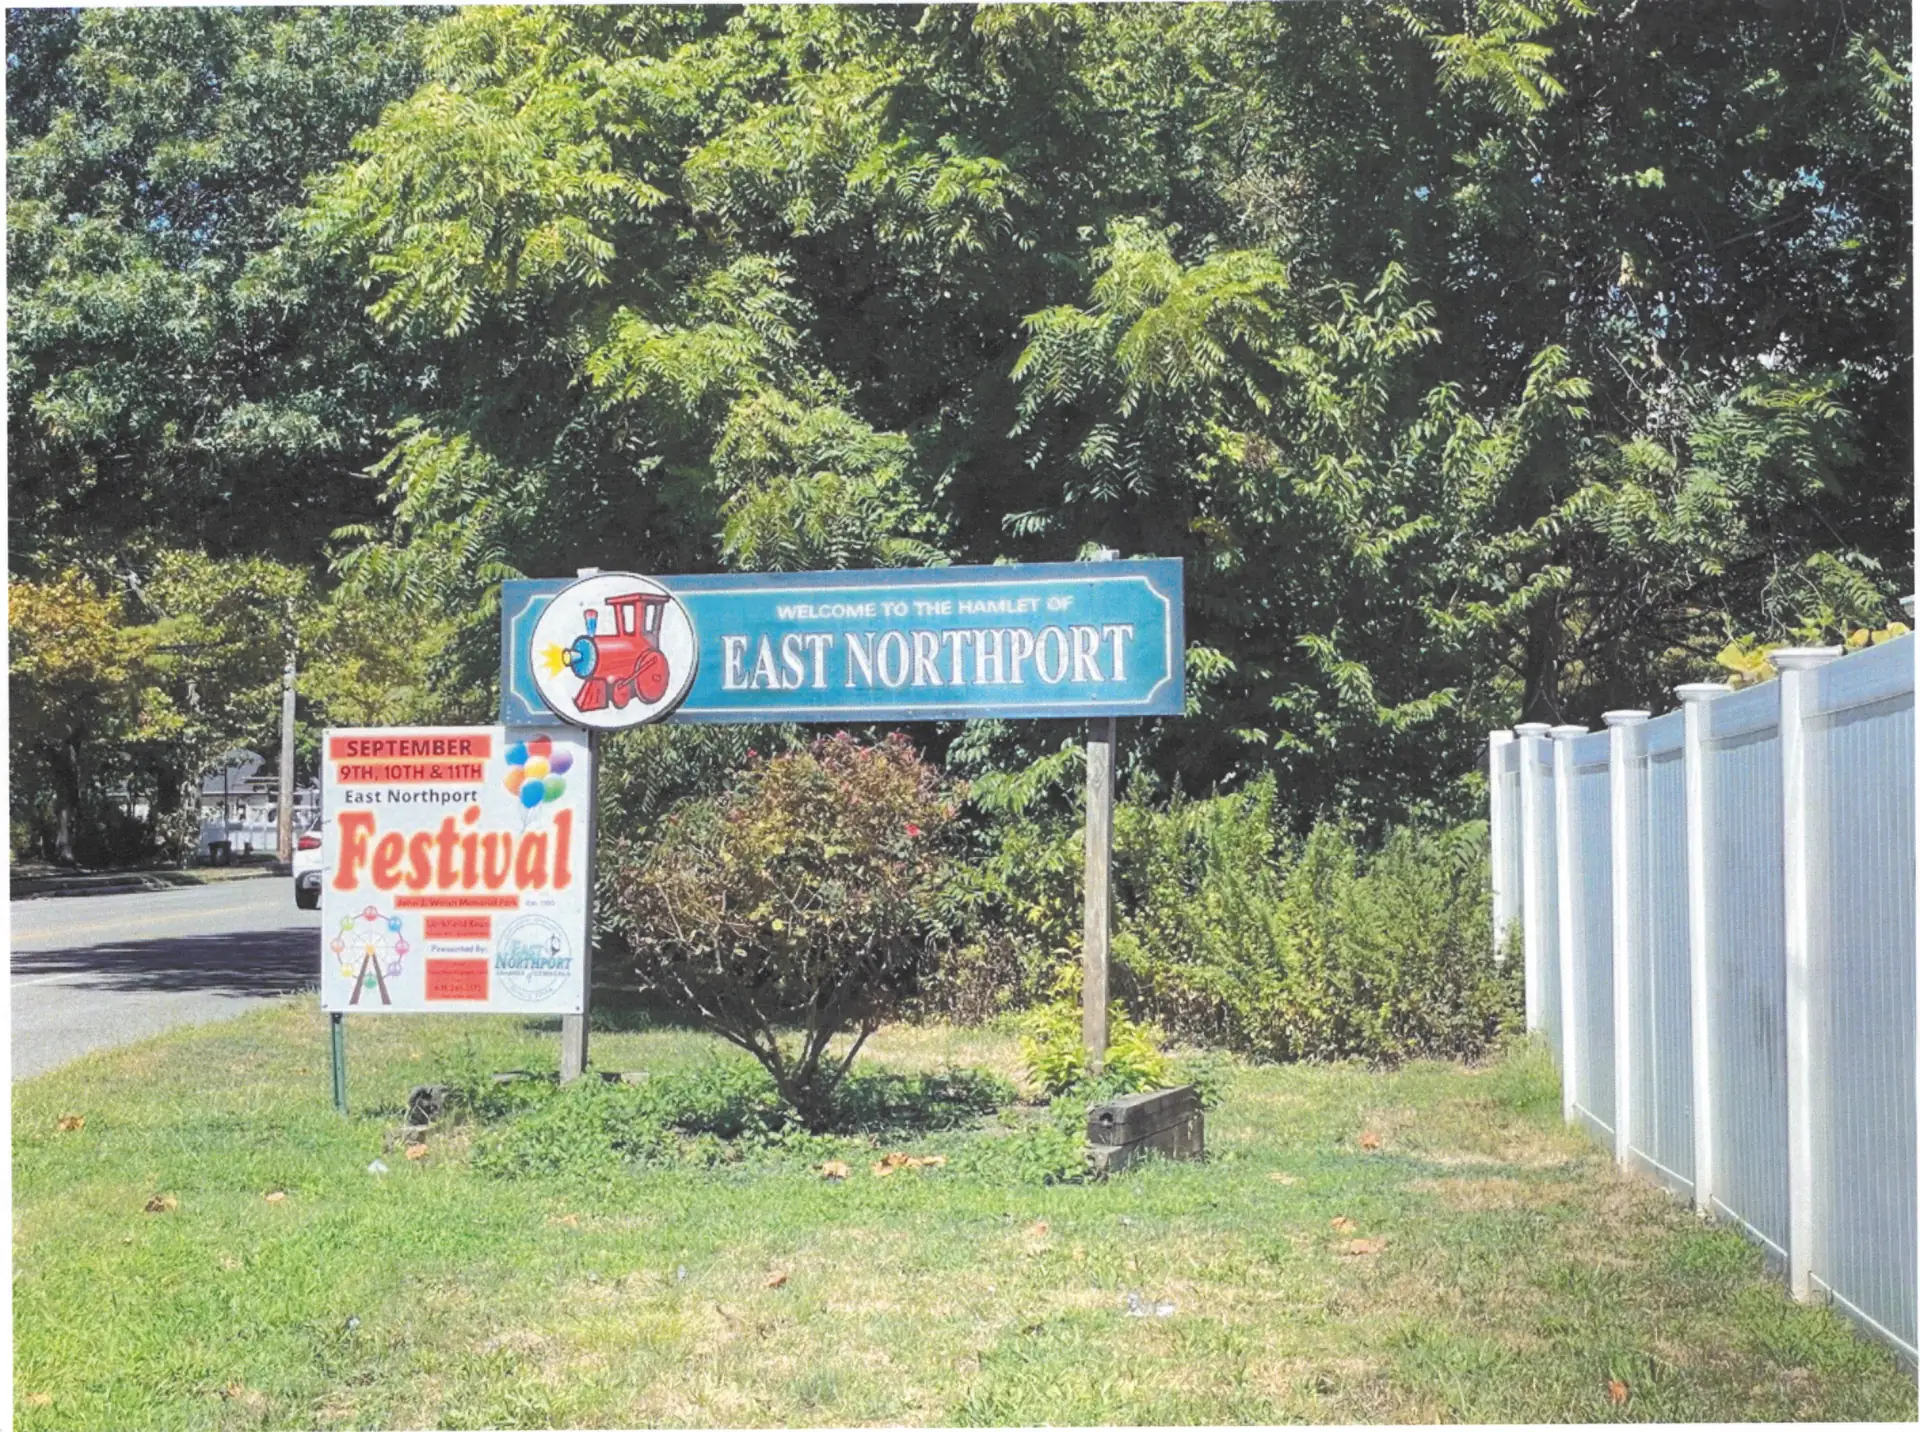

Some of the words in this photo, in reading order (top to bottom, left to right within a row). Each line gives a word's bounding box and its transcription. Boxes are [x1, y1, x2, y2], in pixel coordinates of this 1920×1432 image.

[776, 602, 876, 620] WELCOME
[881, 602, 909, 618] TO
[913, 600, 952, 617] THE
[957, 598, 1039, 615] HAMLET
[1047, 596, 1075, 612] OF
[720, 632, 834, 691] EAST
[844, 623, 1135, 689] NORTHPORT
[347, 739, 472, 757] SEPTEMBER
[385, 764, 424, 780] 10TH
[430, 763, 443, 780] &
[448, 763, 482, 780] 11TH
[345, 789, 382, 804] East
[387, 788, 478, 805] Northport
[332, 805, 573, 890] Festival
